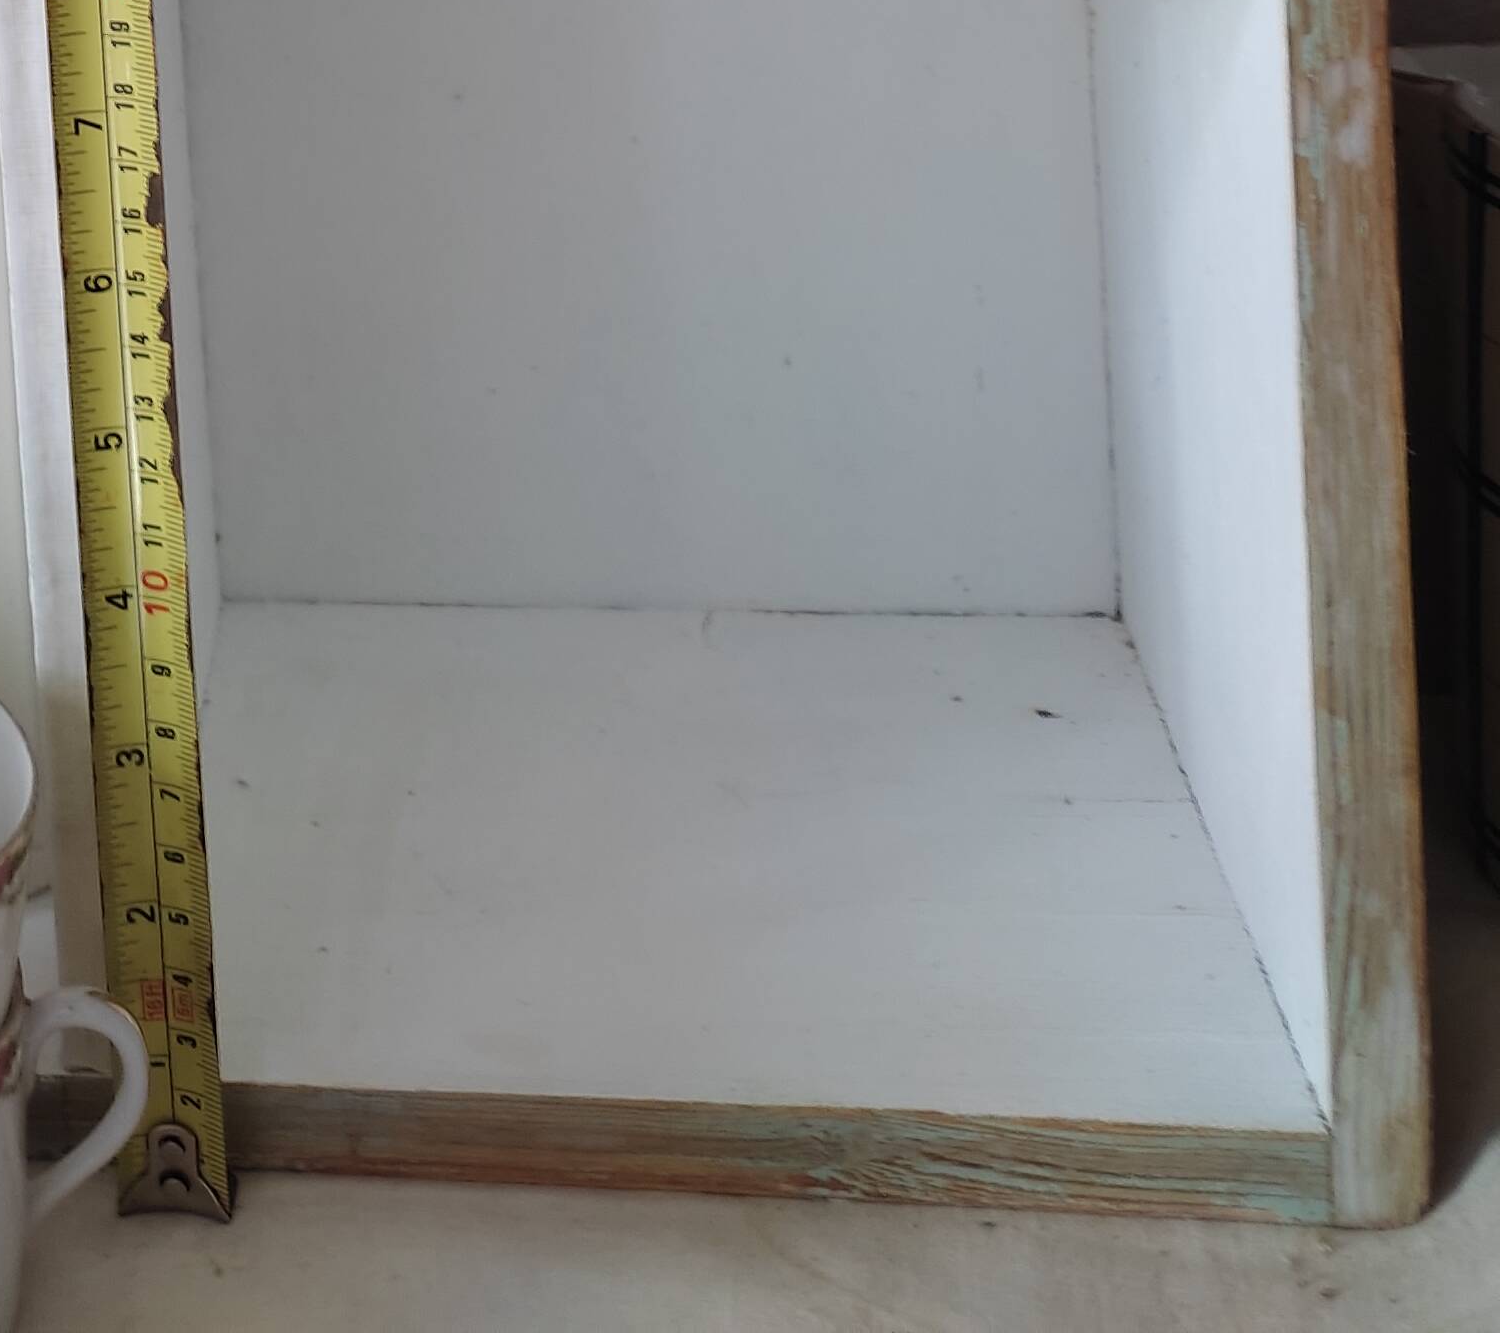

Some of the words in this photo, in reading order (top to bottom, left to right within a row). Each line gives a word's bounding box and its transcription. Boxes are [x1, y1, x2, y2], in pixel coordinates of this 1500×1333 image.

[109, 21, 131, 49] 19
[114, 83, 134, 110] 18
[73, 118, 103, 137] 7
[118, 145, 139, 173] 17
[121, 207, 142, 236] 16
[84, 274, 113, 293] 6
[125, 270, 146, 298] 15
[130, 333, 150, 360] 14
[134, 395, 154, 421] 13
[93, 432, 123, 451] 5
[138, 458, 159, 485] 12
[142, 522, 163, 547] 11
[105, 589, 133, 610] 4
[142, 570, 170, 615] 10
[151, 664, 172, 677] 9
[155, 727, 176, 739] 8
[116, 748, 145, 766] 3
[160, 788, 181, 803] 7
[163, 851, 185, 864] 6
[126, 904, 155, 924] 2
[168, 912, 189, 926] 5
[172, 973, 193, 987] 4
[176, 1034, 197, 1048] 3
[151, 1059, 166, 1067] 1
[180, 1095, 201, 1110] 2
